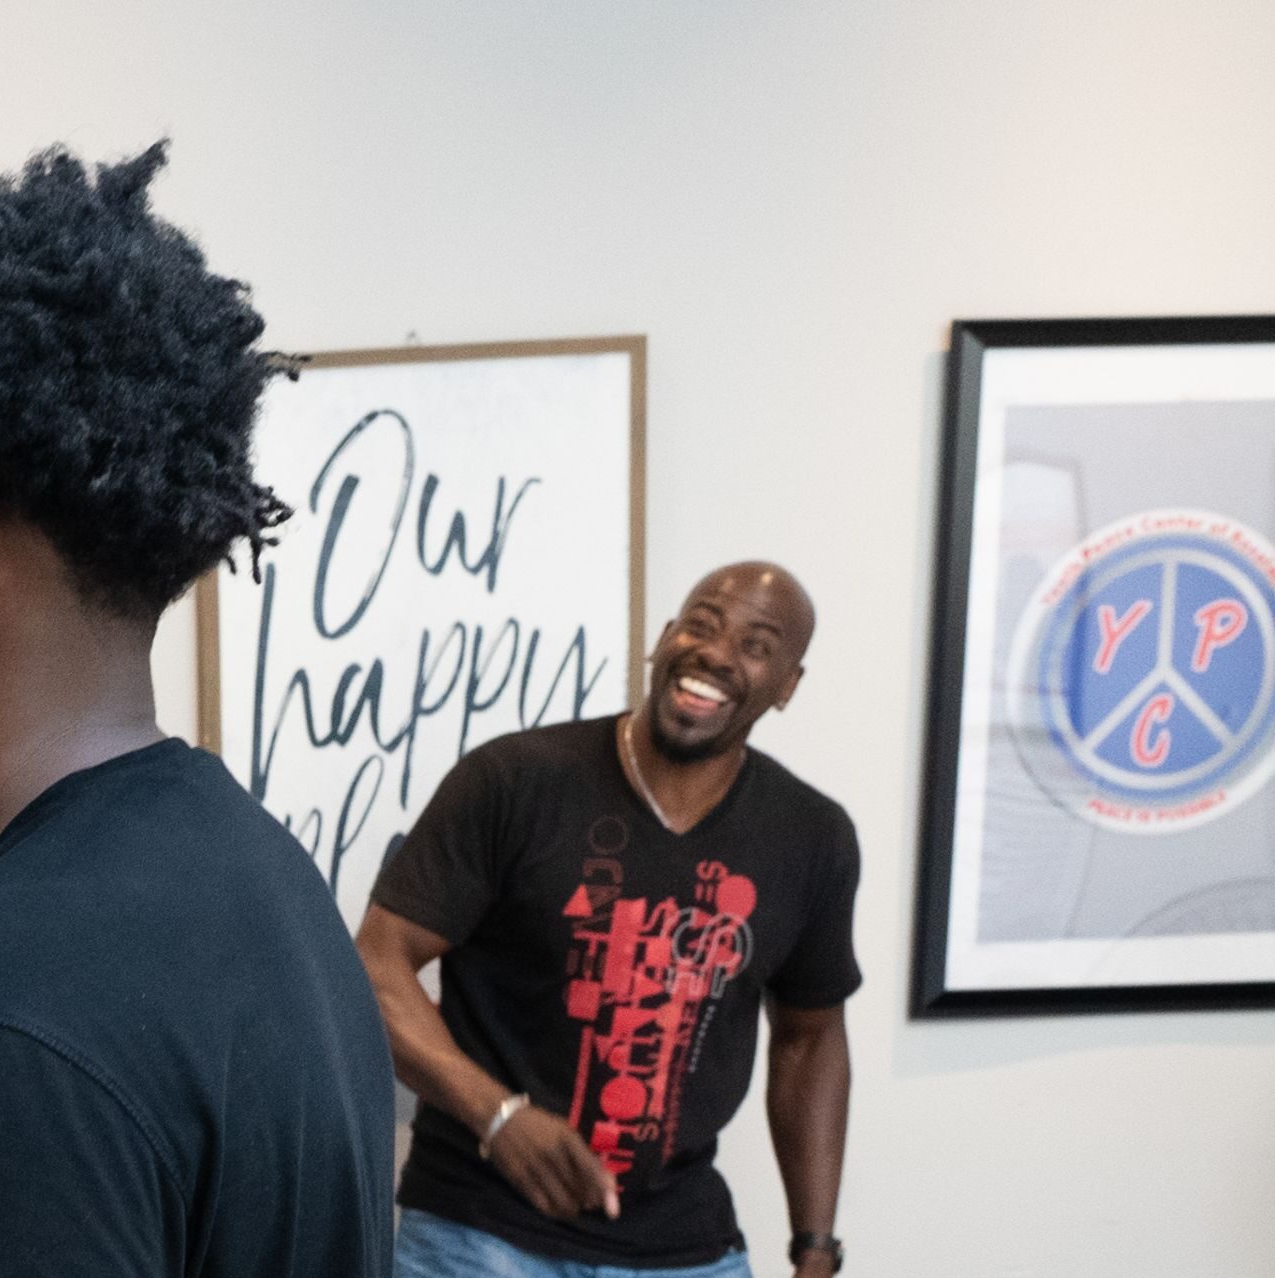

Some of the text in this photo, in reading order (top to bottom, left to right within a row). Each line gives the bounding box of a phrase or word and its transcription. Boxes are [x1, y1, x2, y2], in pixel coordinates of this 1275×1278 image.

[309, 408, 541, 642] Our
[250, 562, 608, 812] happy
[1093, 599, 1249, 674] Y P
[1128, 693, 1175, 769] C
